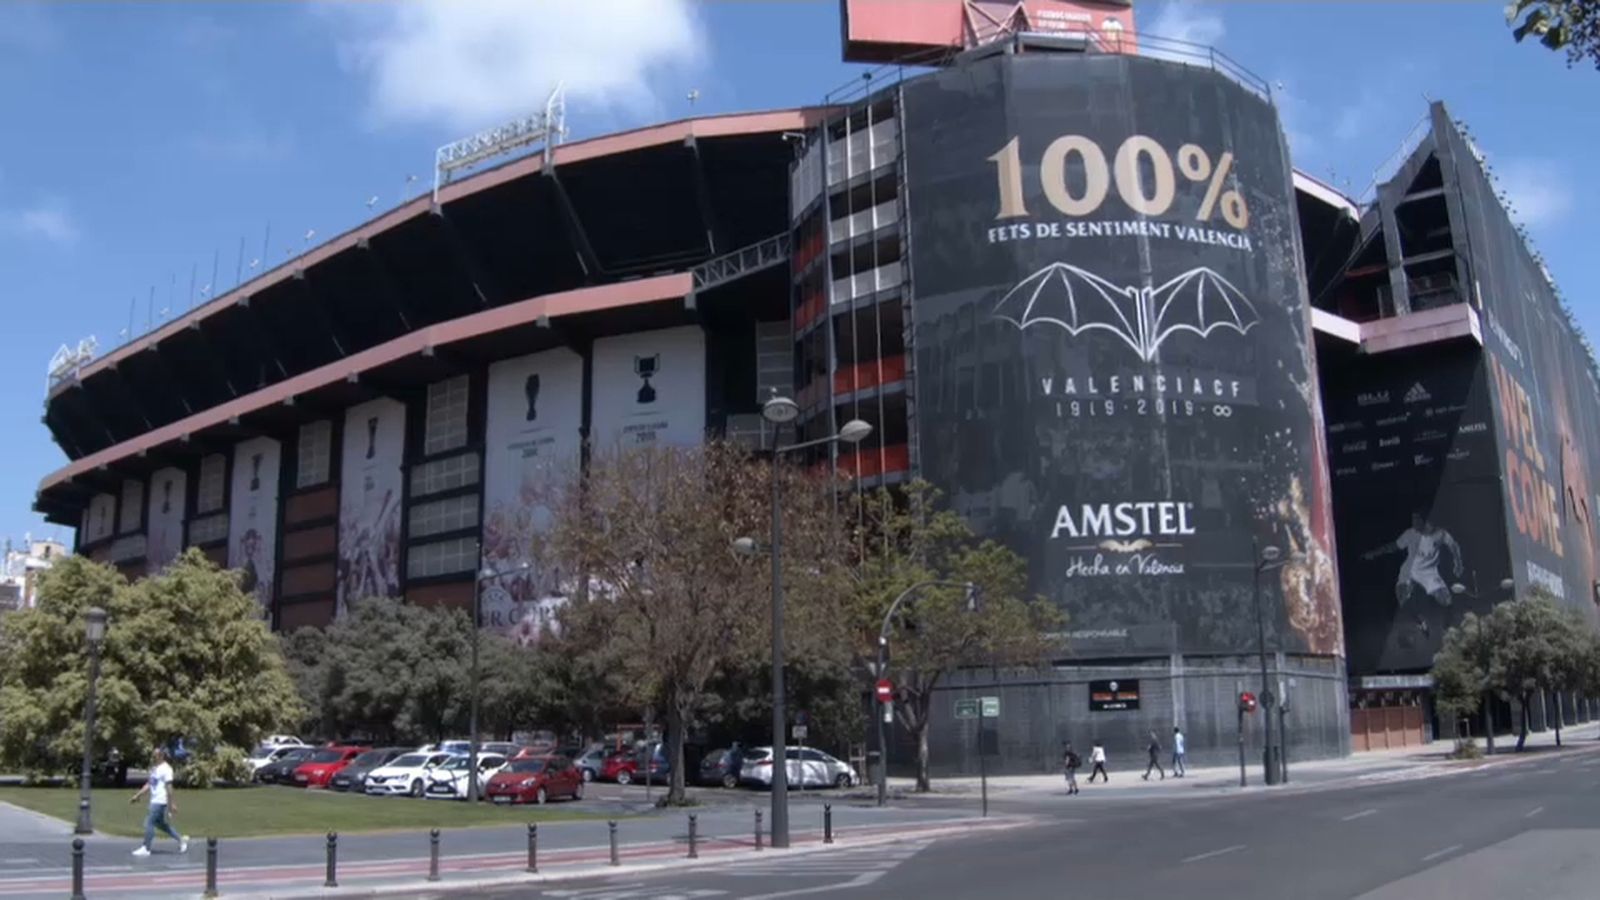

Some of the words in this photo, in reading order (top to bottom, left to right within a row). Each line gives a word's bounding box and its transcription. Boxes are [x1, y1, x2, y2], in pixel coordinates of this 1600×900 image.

[986, 134, 1249, 230] 100%
[987, 222, 1031, 244] FETS
[1036, 221, 1062, 239] DE
[1066, 220, 1170, 239] SENTIMENT
[1050, 501, 1196, 539] AMSTEL
[1065, 553, 1111, 578] Hecha
[1115, 563, 1131, 575] en
